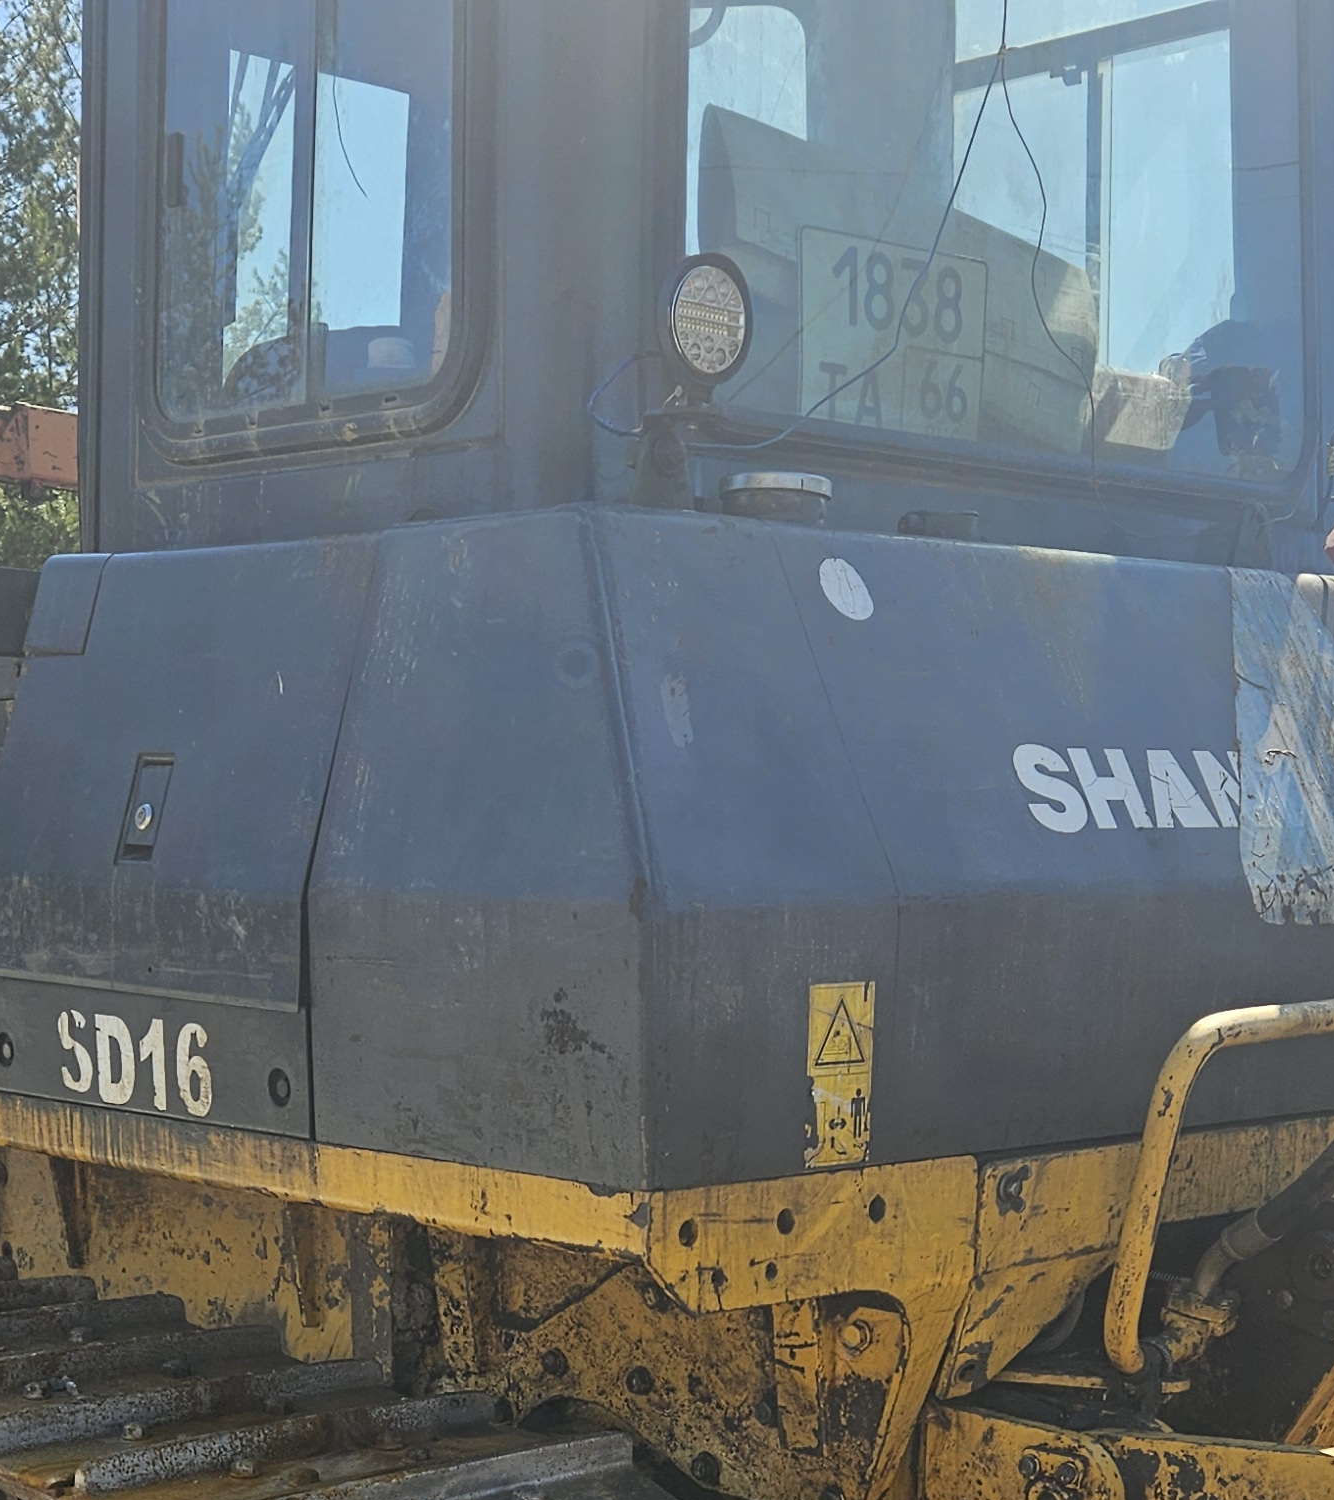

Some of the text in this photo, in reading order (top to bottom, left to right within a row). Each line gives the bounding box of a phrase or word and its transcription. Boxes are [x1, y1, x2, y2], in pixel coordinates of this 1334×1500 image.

[831, 245, 963, 344] 1838
[919, 358, 967, 423] 66
[57, 1009, 213, 1118] SD16
